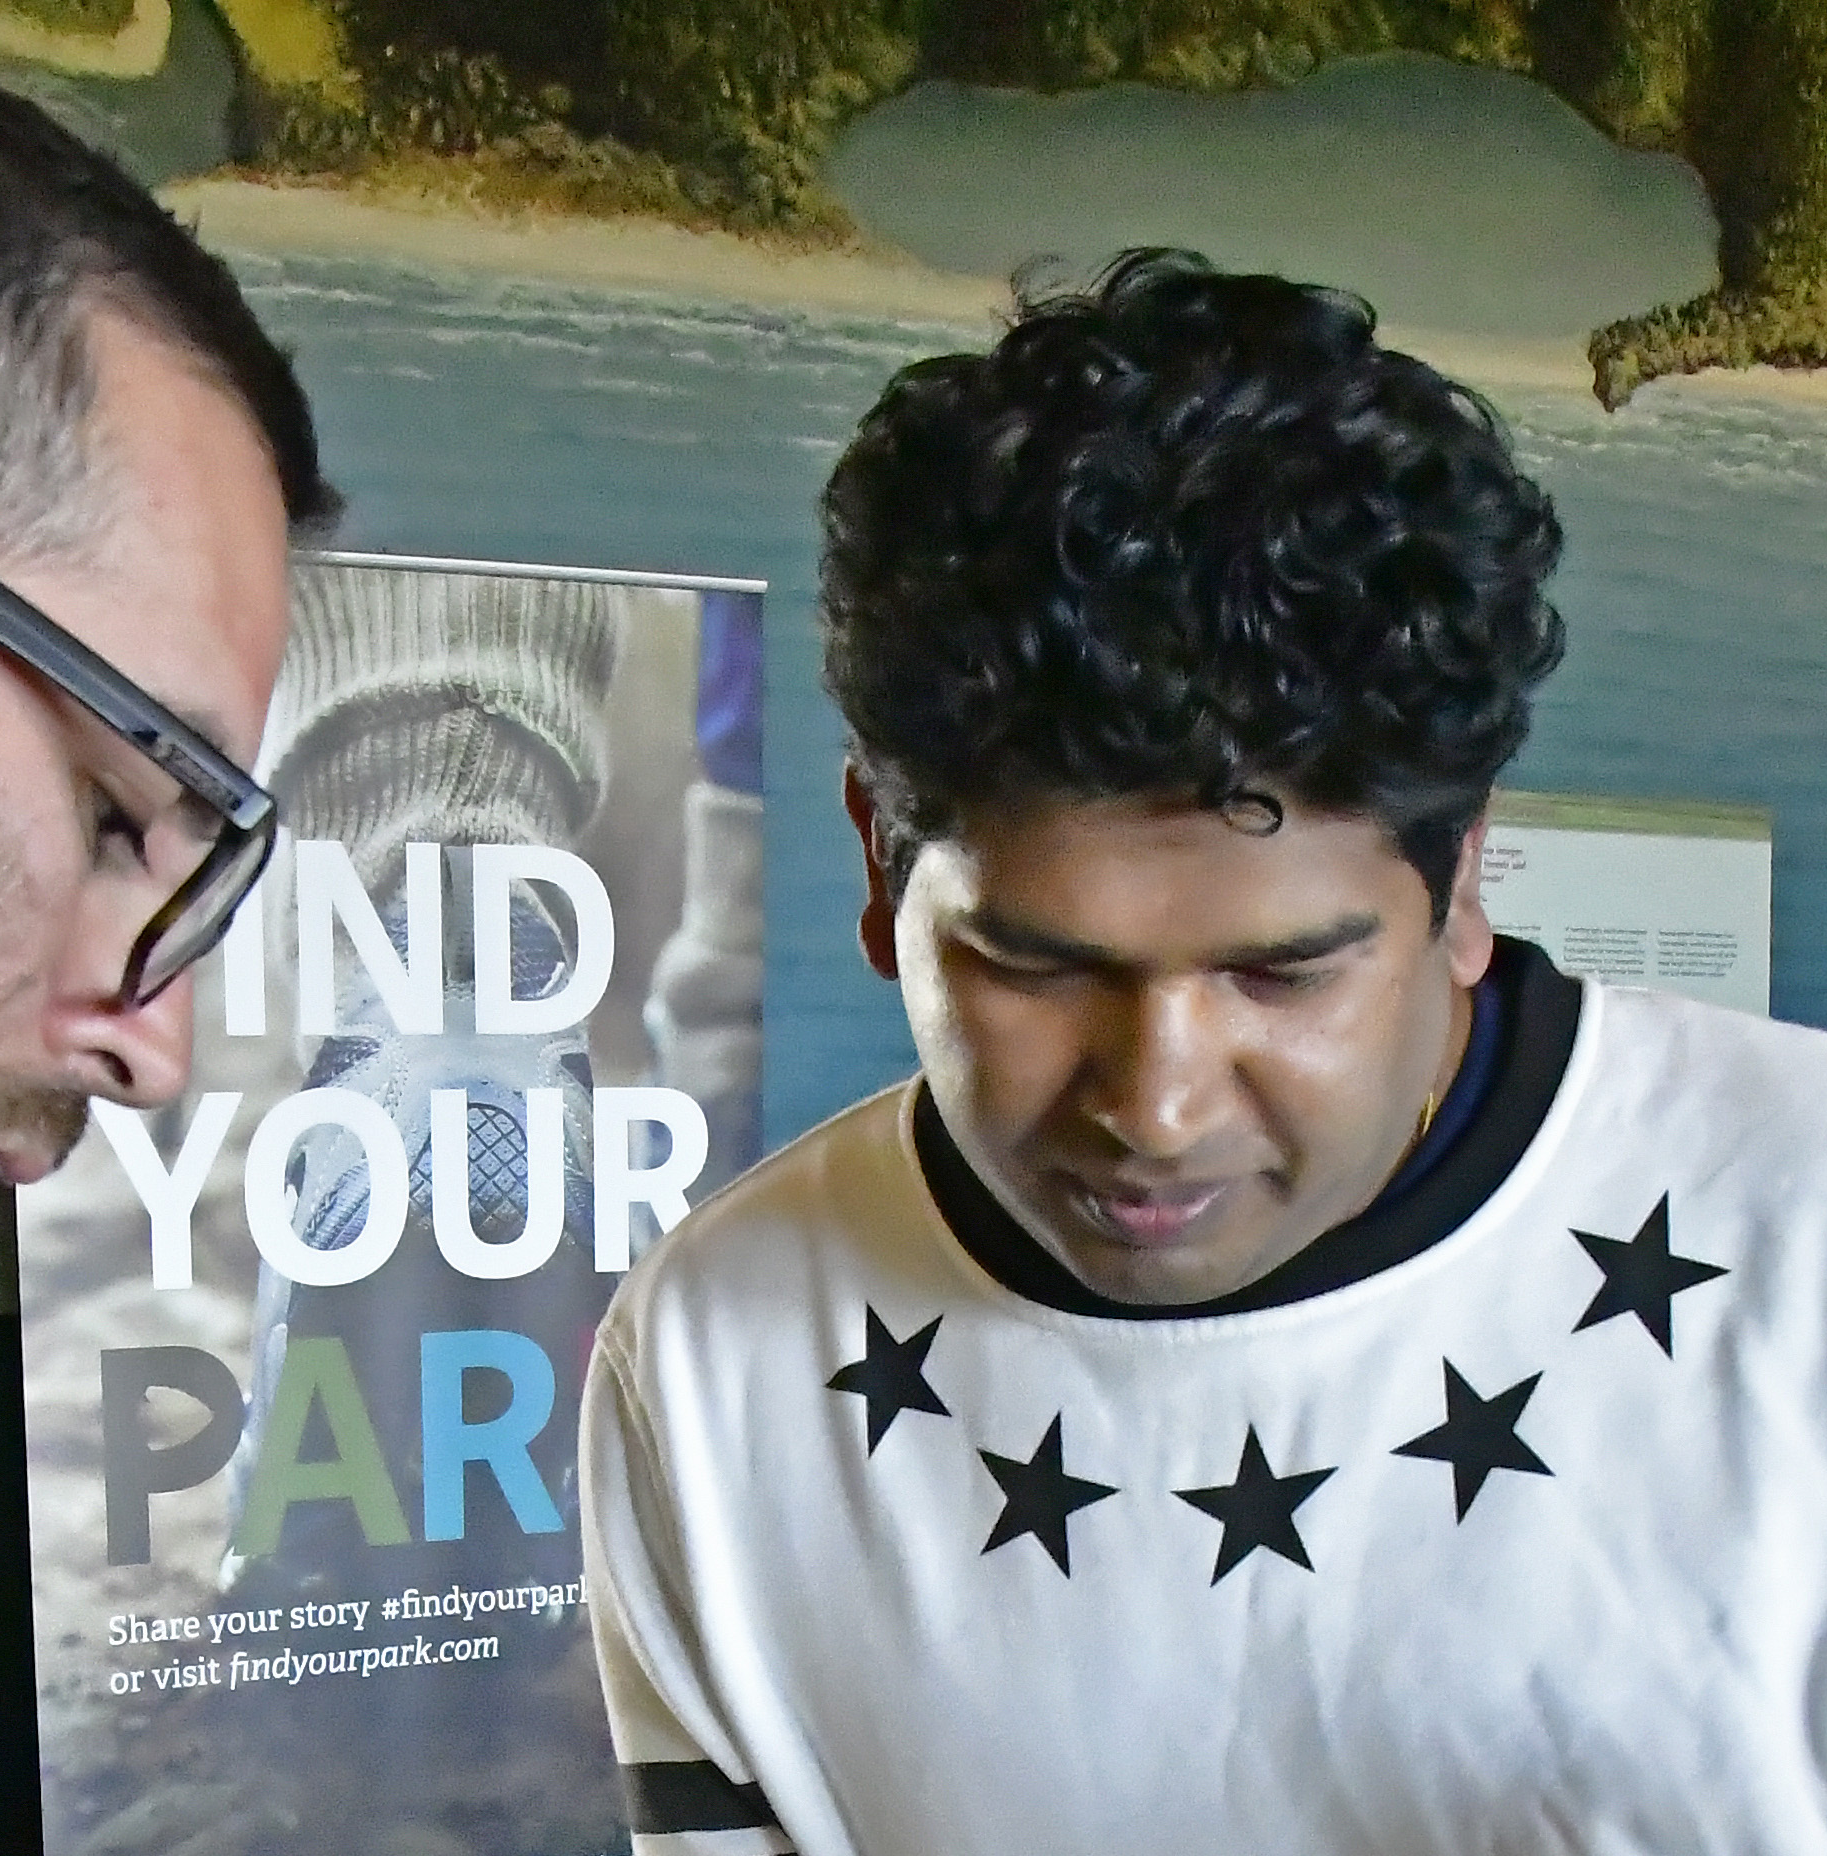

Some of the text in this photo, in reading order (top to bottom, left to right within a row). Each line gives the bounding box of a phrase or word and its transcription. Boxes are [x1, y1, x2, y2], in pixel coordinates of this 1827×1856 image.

[221, 840, 615, 1037] IND
[90, 1085, 709, 1290] YOUR
[100, 1329, 567, 1567] PAR
[108, 1614, 201, 1646] Share
[208, 1608, 283, 1644] your
[290, 1601, 370, 1631] story
[109, 1635, 500, 1695] or visit findyourpark.com
